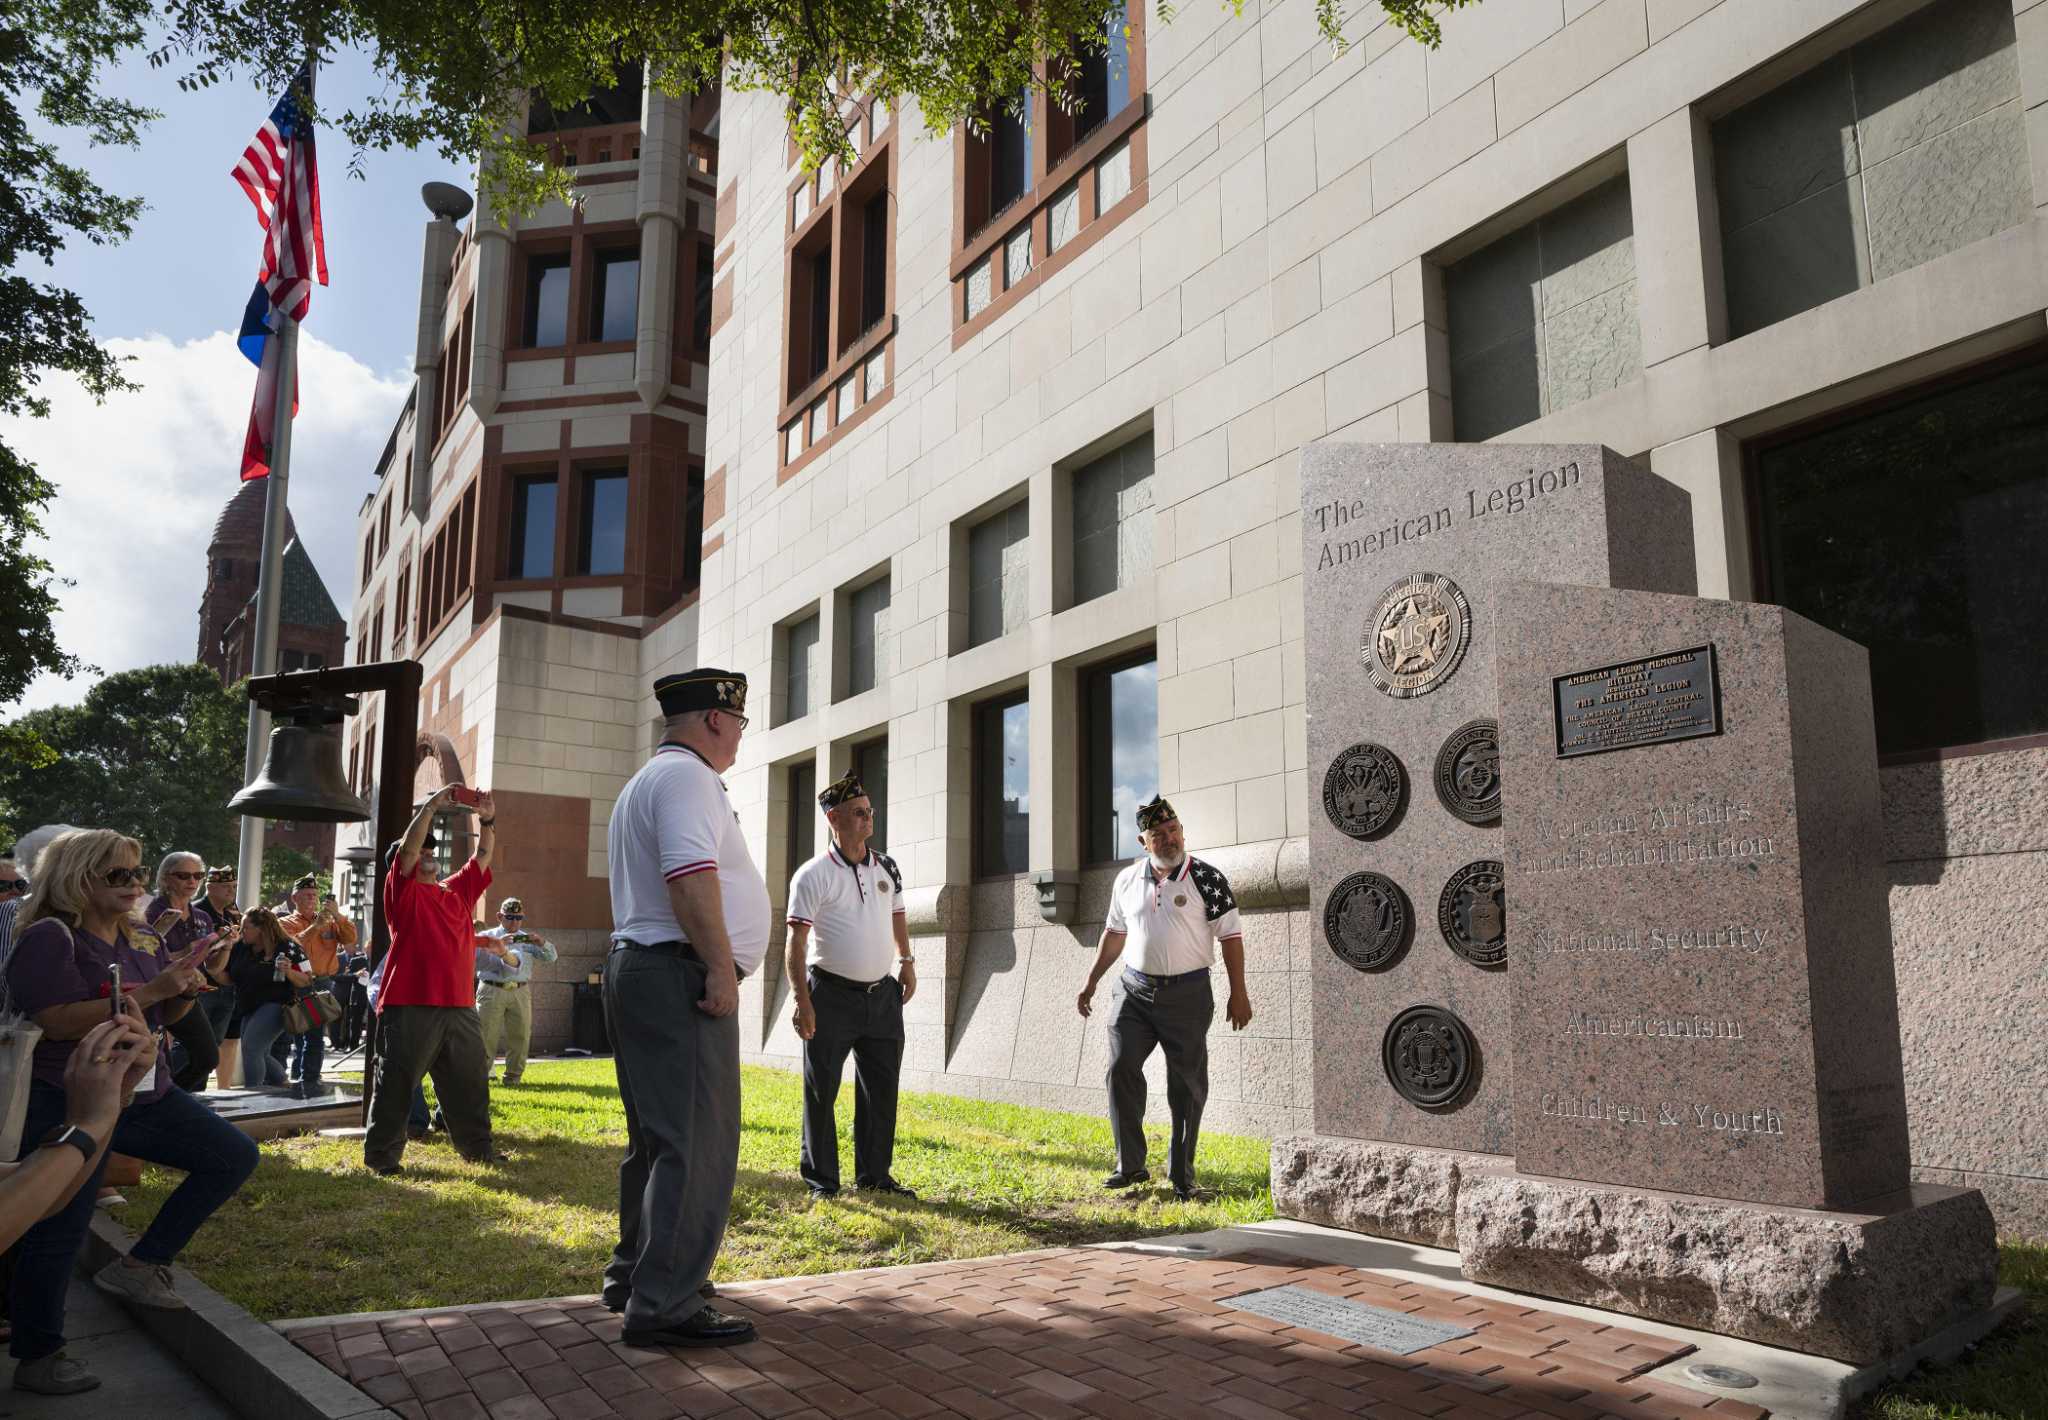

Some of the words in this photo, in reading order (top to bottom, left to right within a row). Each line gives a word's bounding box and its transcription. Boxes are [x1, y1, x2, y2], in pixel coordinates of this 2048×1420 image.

[1315, 498, 1365, 533] The
[1317, 505, 1452, 571] American
[1467, 461, 1581, 520] Legion
[1401, 623, 1426, 650] US
[1568, 670, 1611, 687] AMERICAN
[1616, 663, 1646, 676] LEGION
[1649, 654, 1696, 669] MEMORIAL
[1607, 673, 1652, 687] HIGHWAY
[1575, 698, 1594, 709] THE
[1600, 687, 1649, 705] AMERICAN
[1655, 680, 1691, 693] LEGION
[1650, 799, 1751, 830] Affairs
[1576, 833, 1776, 871] Rehabilitation
[1535, 926, 1641, 953] National
[1648, 922, 1769, 954] Security
[1564, 1008, 1744, 1039] Americanism
[1541, 1093, 1649, 1123] Children
[1658, 1101, 1679, 1126] &
[1692, 1102, 1784, 1135] Youth
